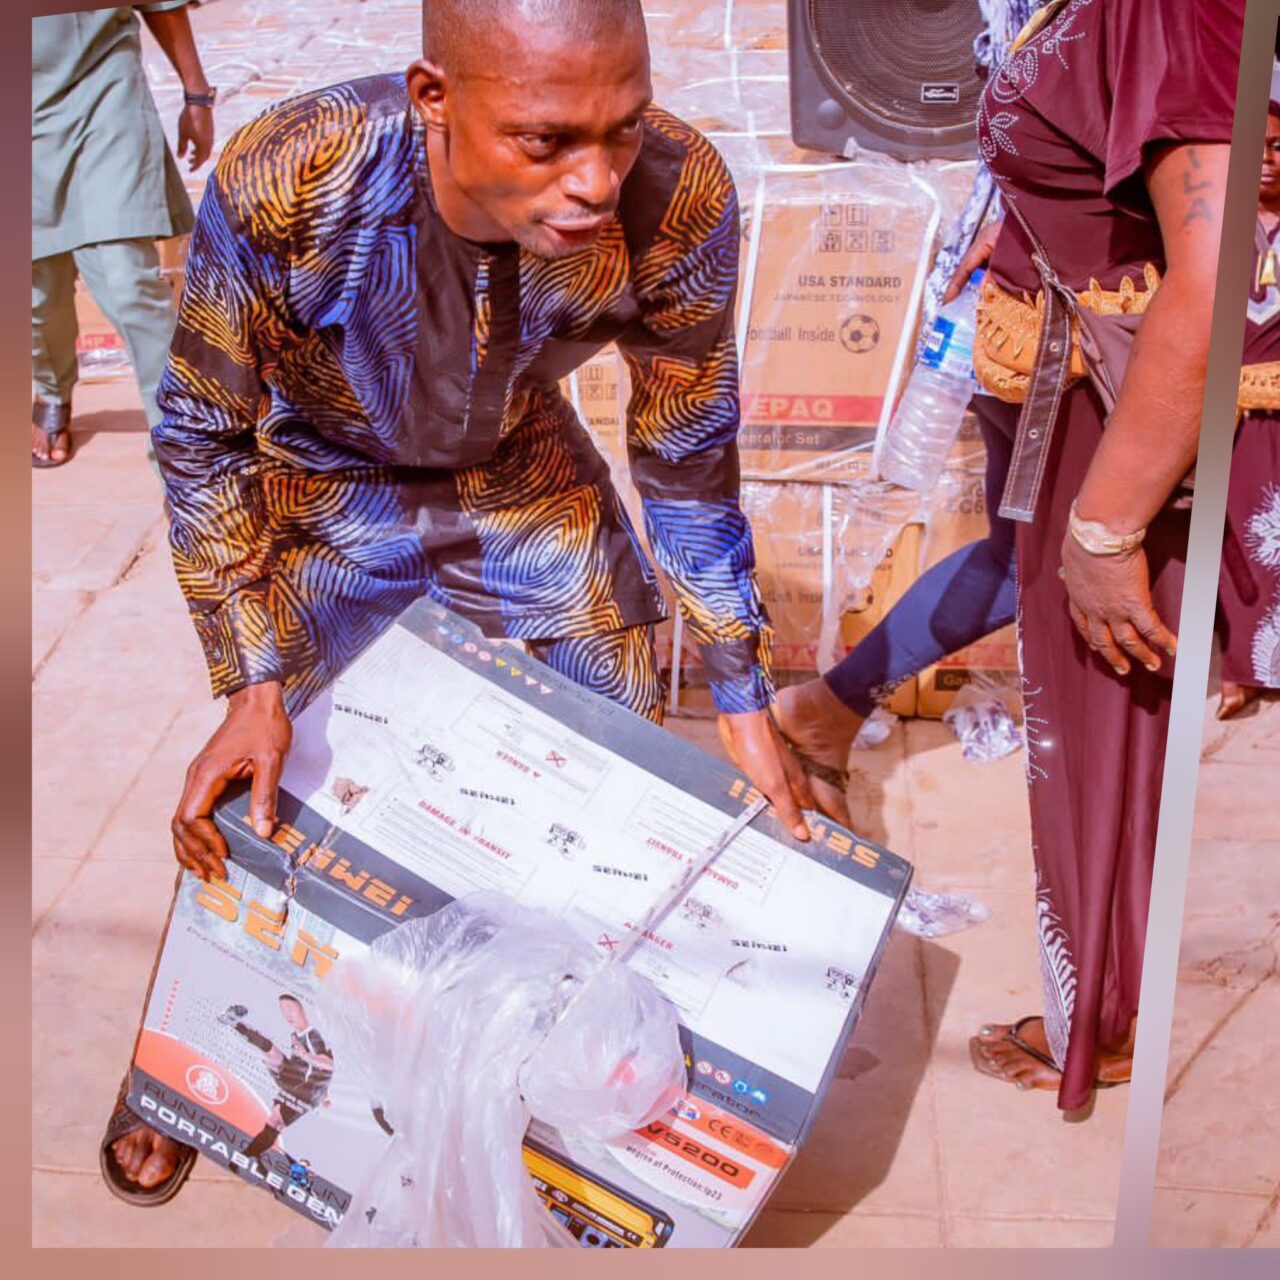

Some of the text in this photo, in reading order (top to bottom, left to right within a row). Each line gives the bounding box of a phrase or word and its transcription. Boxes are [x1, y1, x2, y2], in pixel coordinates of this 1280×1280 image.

[797, 275, 903, 289] USA STANDARD
[798, 326, 836, 342] Inside
[418, 799, 457, 828] DAMAGE
[473, 834, 513, 861] TRANSIT
[243, 814, 414, 917] ENWEI
[195, 875, 340, 982] SEN
[641, 927, 675, 952] ANGER
[139, 1094, 285, 1191] PORTABLE
[143, 1079, 198, 1124] RUN
[197, 1109, 237, 1149] ON
